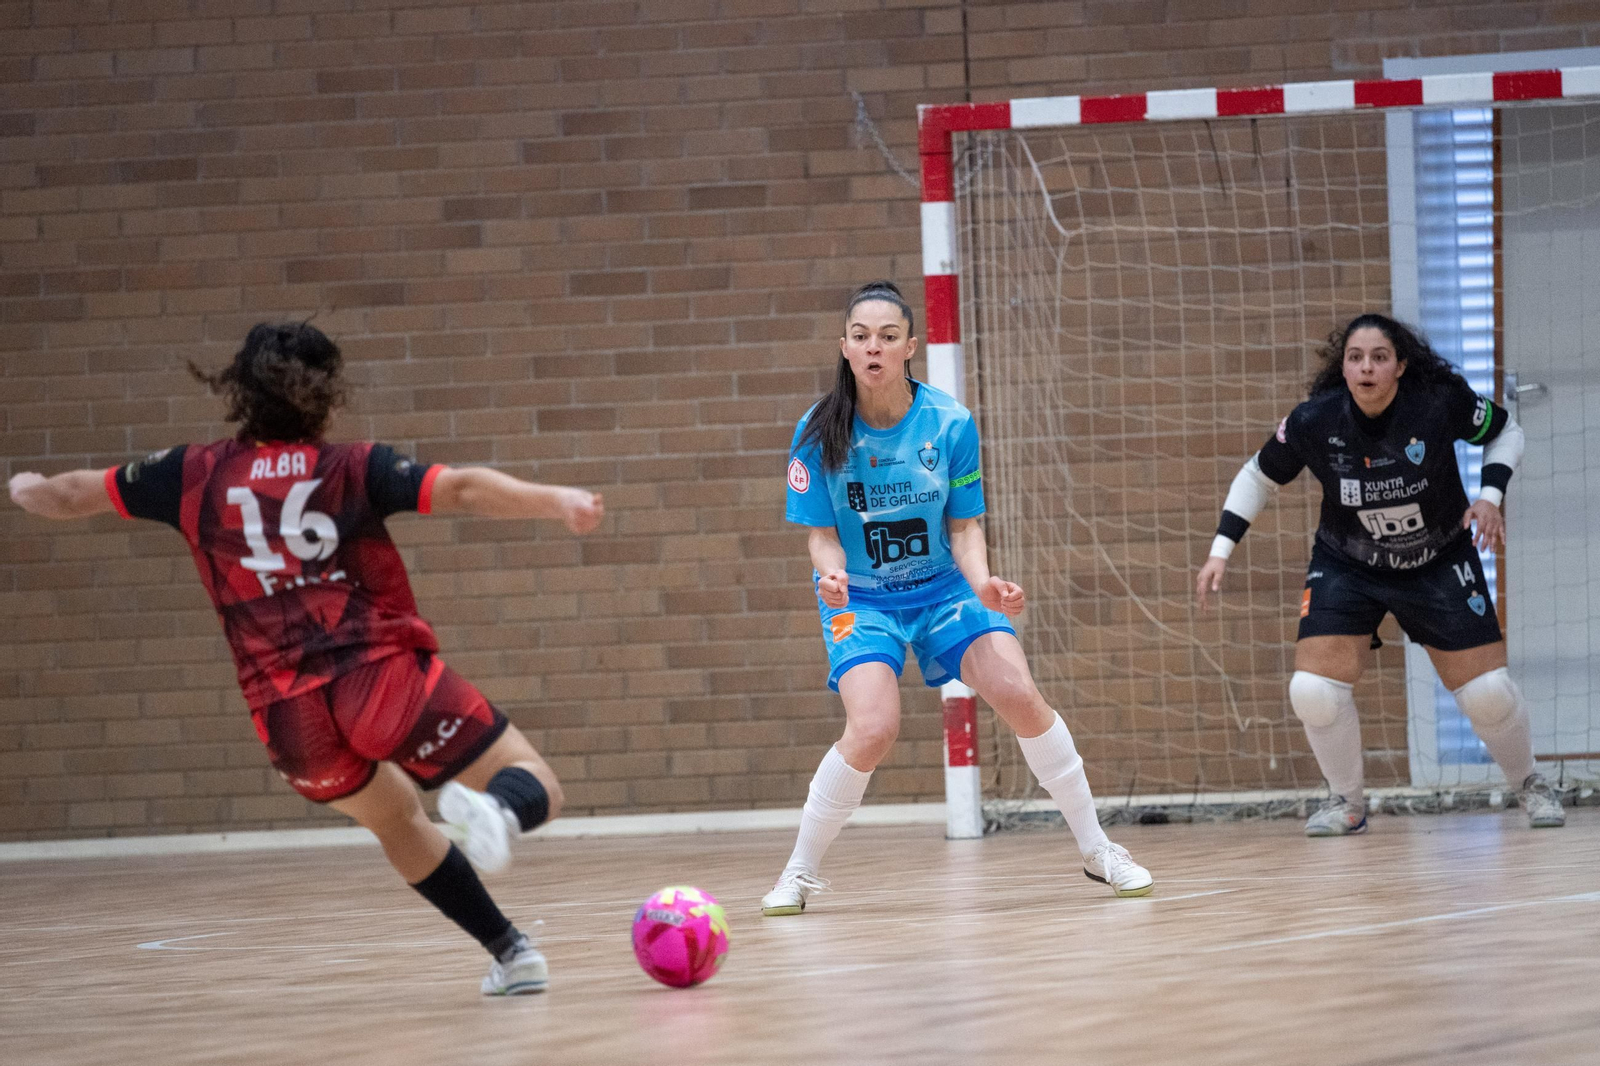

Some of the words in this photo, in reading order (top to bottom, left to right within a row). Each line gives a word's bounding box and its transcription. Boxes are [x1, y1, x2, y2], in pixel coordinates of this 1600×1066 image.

[250, 451, 306, 480] ALBA
[869, 481, 912, 496] XUNTA
[1364, 477, 1404, 492] XUNTA
[1365, 492, 1380, 502] DE
[1382, 478, 1429, 500] GALICIA
[871, 496, 886, 508] DE
[889, 490, 940, 506] GALICIA
[226, 477, 339, 571] 16
[1366, 511, 1425, 540] jba
[869, 526, 930, 569] jba
[889, 558, 933, 573] SERVICIOS
[1367, 552, 1382, 568] J.
[870, 565, 934, 582] INMOBILIARIOS
[1452, 561, 1476, 587] 14
